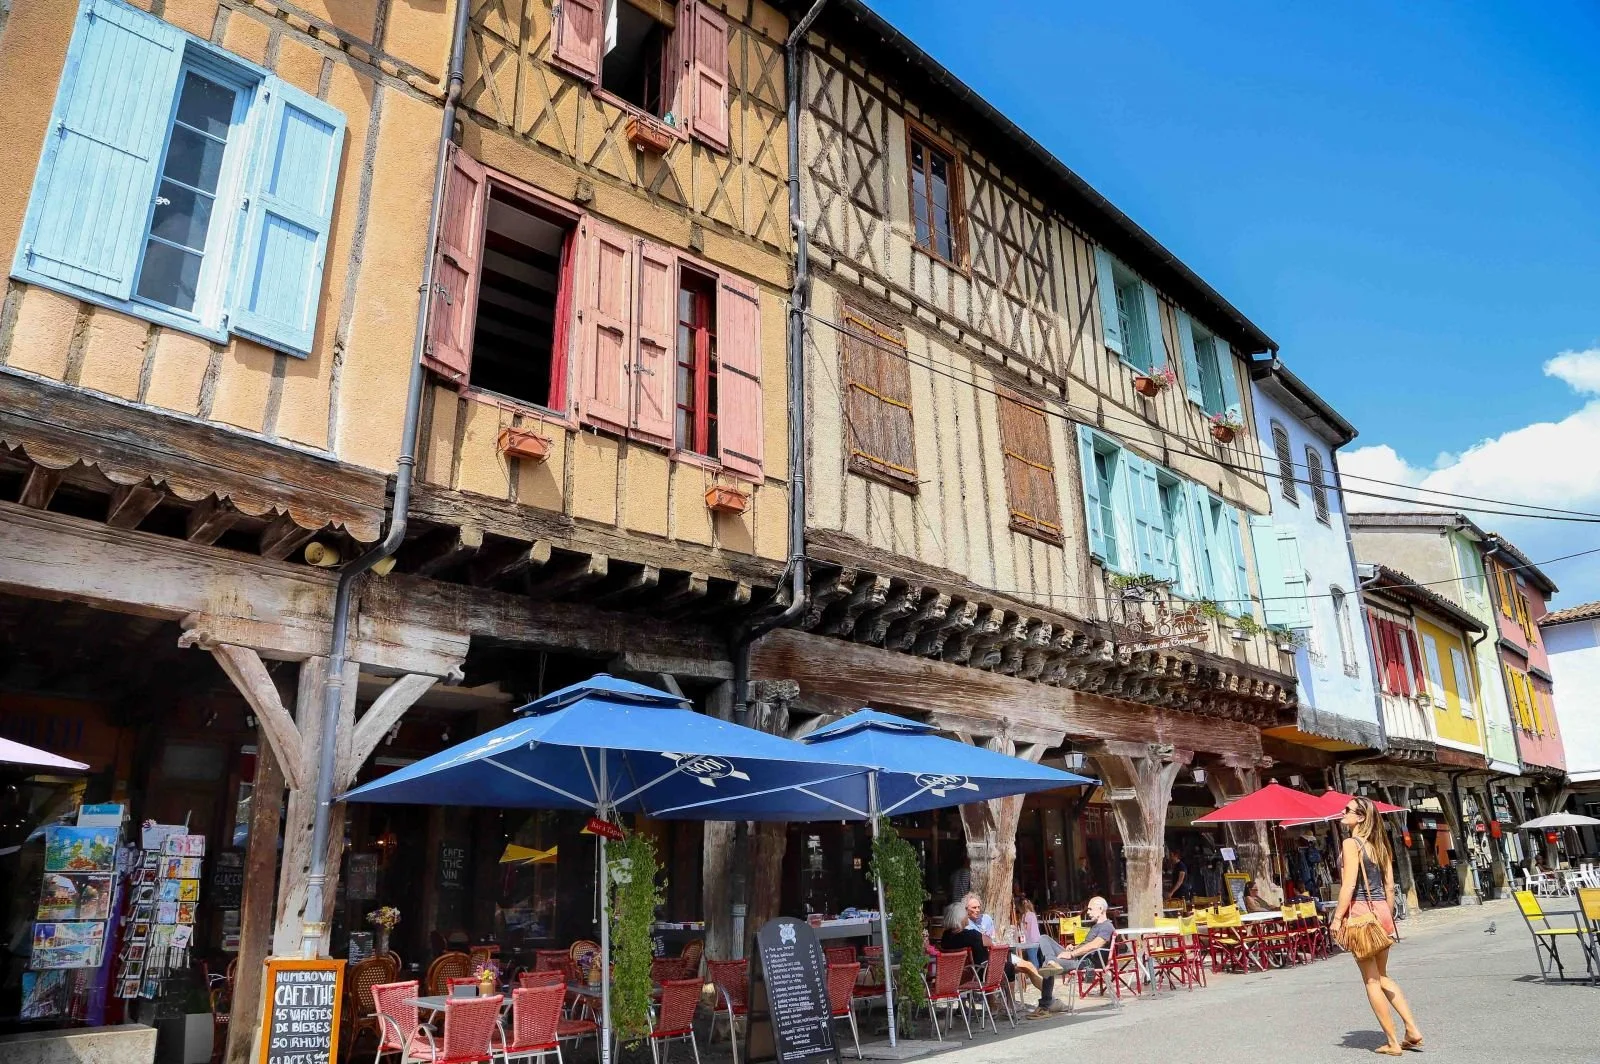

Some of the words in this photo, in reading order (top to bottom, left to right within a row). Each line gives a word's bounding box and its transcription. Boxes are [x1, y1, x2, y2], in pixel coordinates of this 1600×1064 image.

[1133, 643, 1158, 653] Maison
[275, 1008, 289, 1020] 45
[275, 1023, 289, 1034] DE
[271, 1037, 288, 1049] 50
